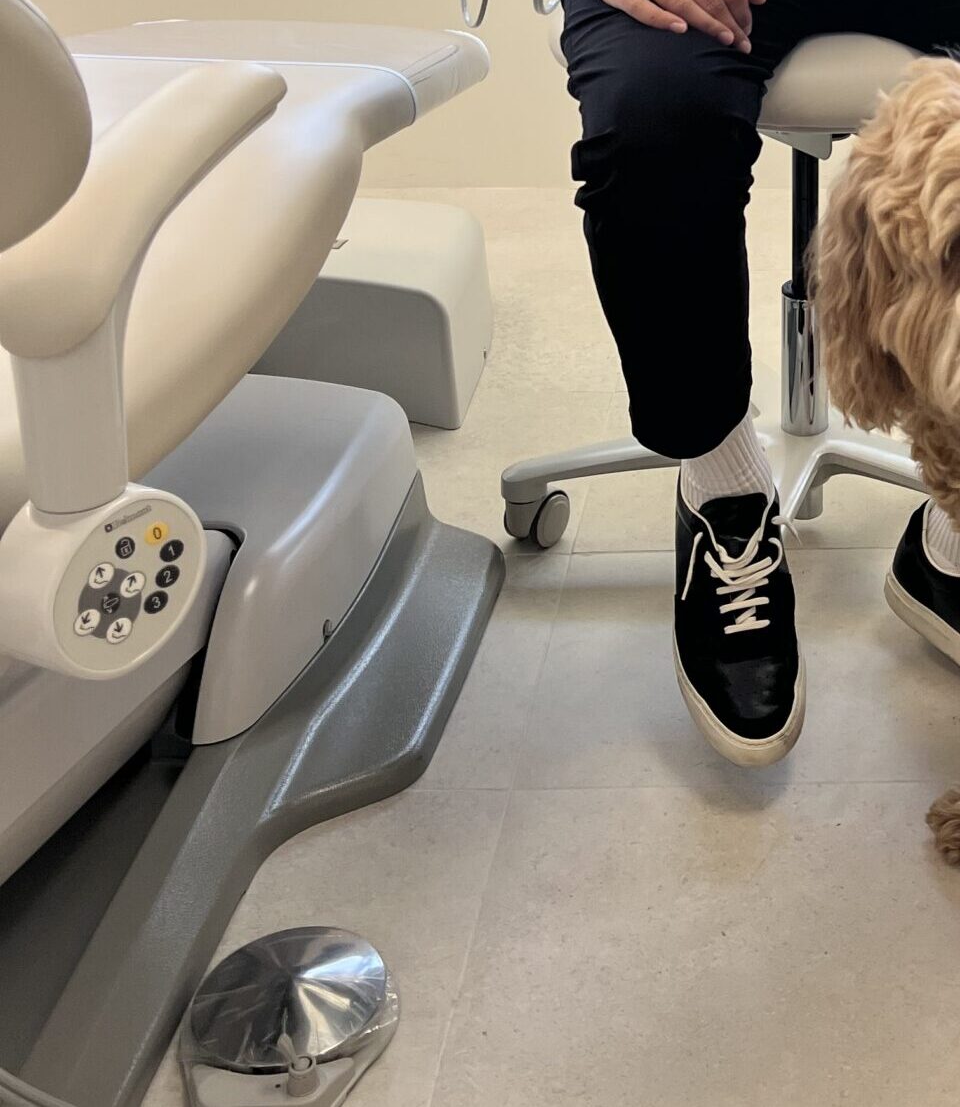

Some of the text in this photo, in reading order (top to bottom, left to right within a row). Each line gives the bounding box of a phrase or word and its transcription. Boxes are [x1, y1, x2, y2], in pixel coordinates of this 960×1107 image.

[152, 527, 162, 540] 0
[168, 545, 176, 556] 1
[163, 570, 173, 583] 2
[151, 596, 161, 609] 3
